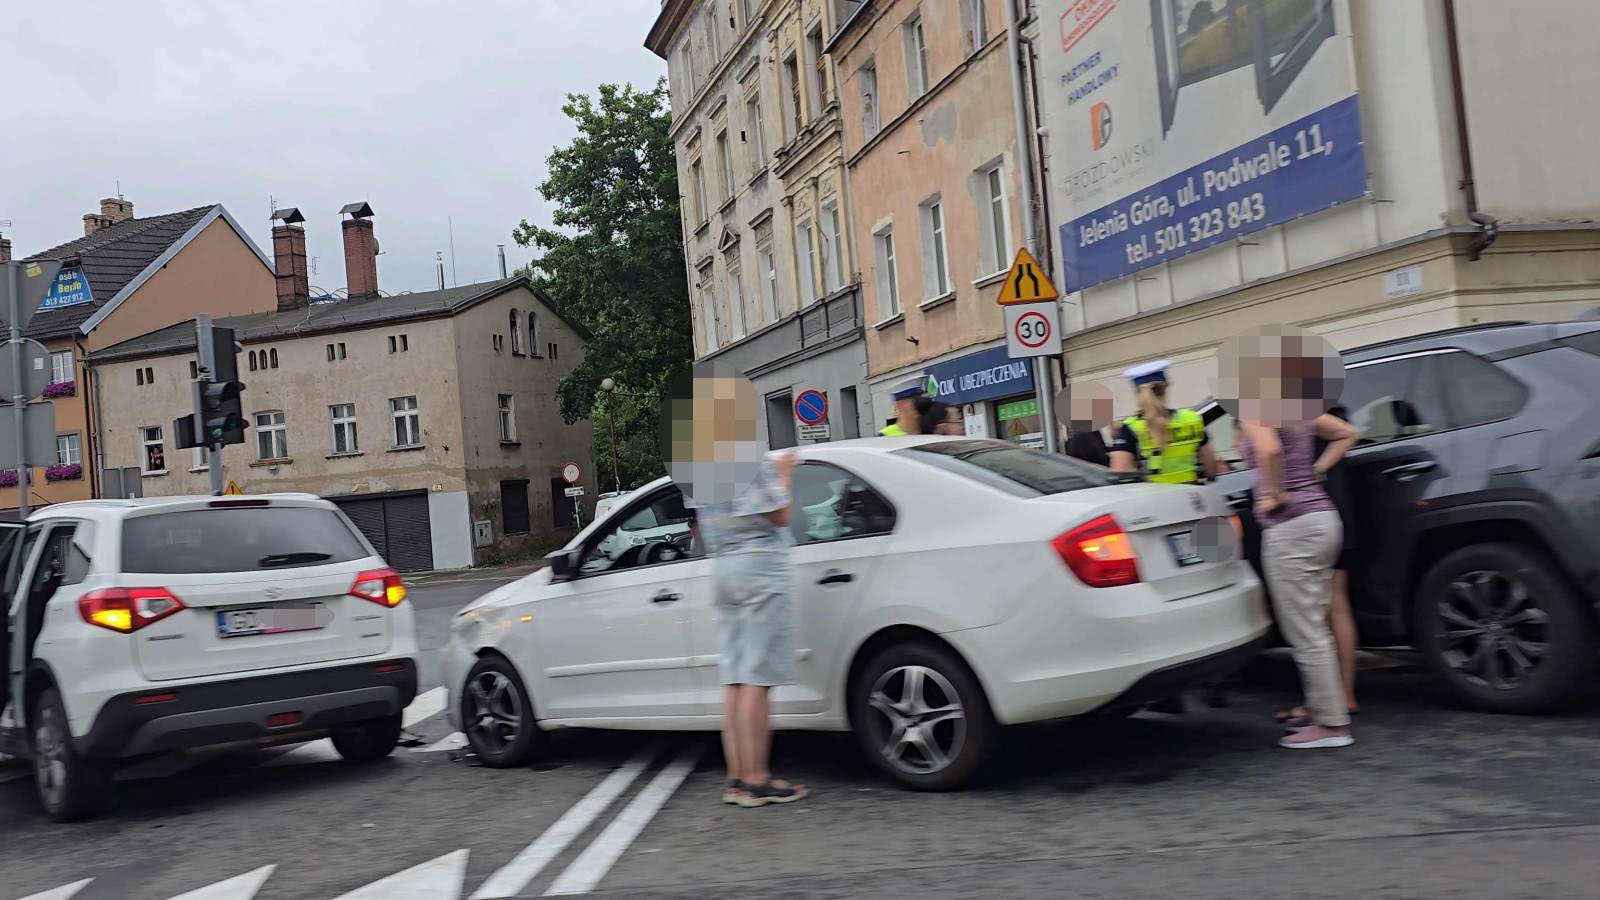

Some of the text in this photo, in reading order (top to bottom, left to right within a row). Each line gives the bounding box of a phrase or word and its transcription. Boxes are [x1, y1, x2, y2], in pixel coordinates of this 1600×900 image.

[1060, 51, 1101, 86] PARTNER
[1067, 64, 1119, 105] HANDLOWY
[1080, 211, 1129, 248] Jelenia
[1130, 194, 1175, 228] Góra,
[1177, 177, 1201, 208] ul.
[1203, 141, 1292, 197] Podwale
[1295, 123, 1333, 161] 11,
[1126, 192, 1266, 264] tel. 501 323 843
[1020, 320, 1047, 339] 30
[939, 360, 1028, 396] CUK UBEZPIECZENIA
